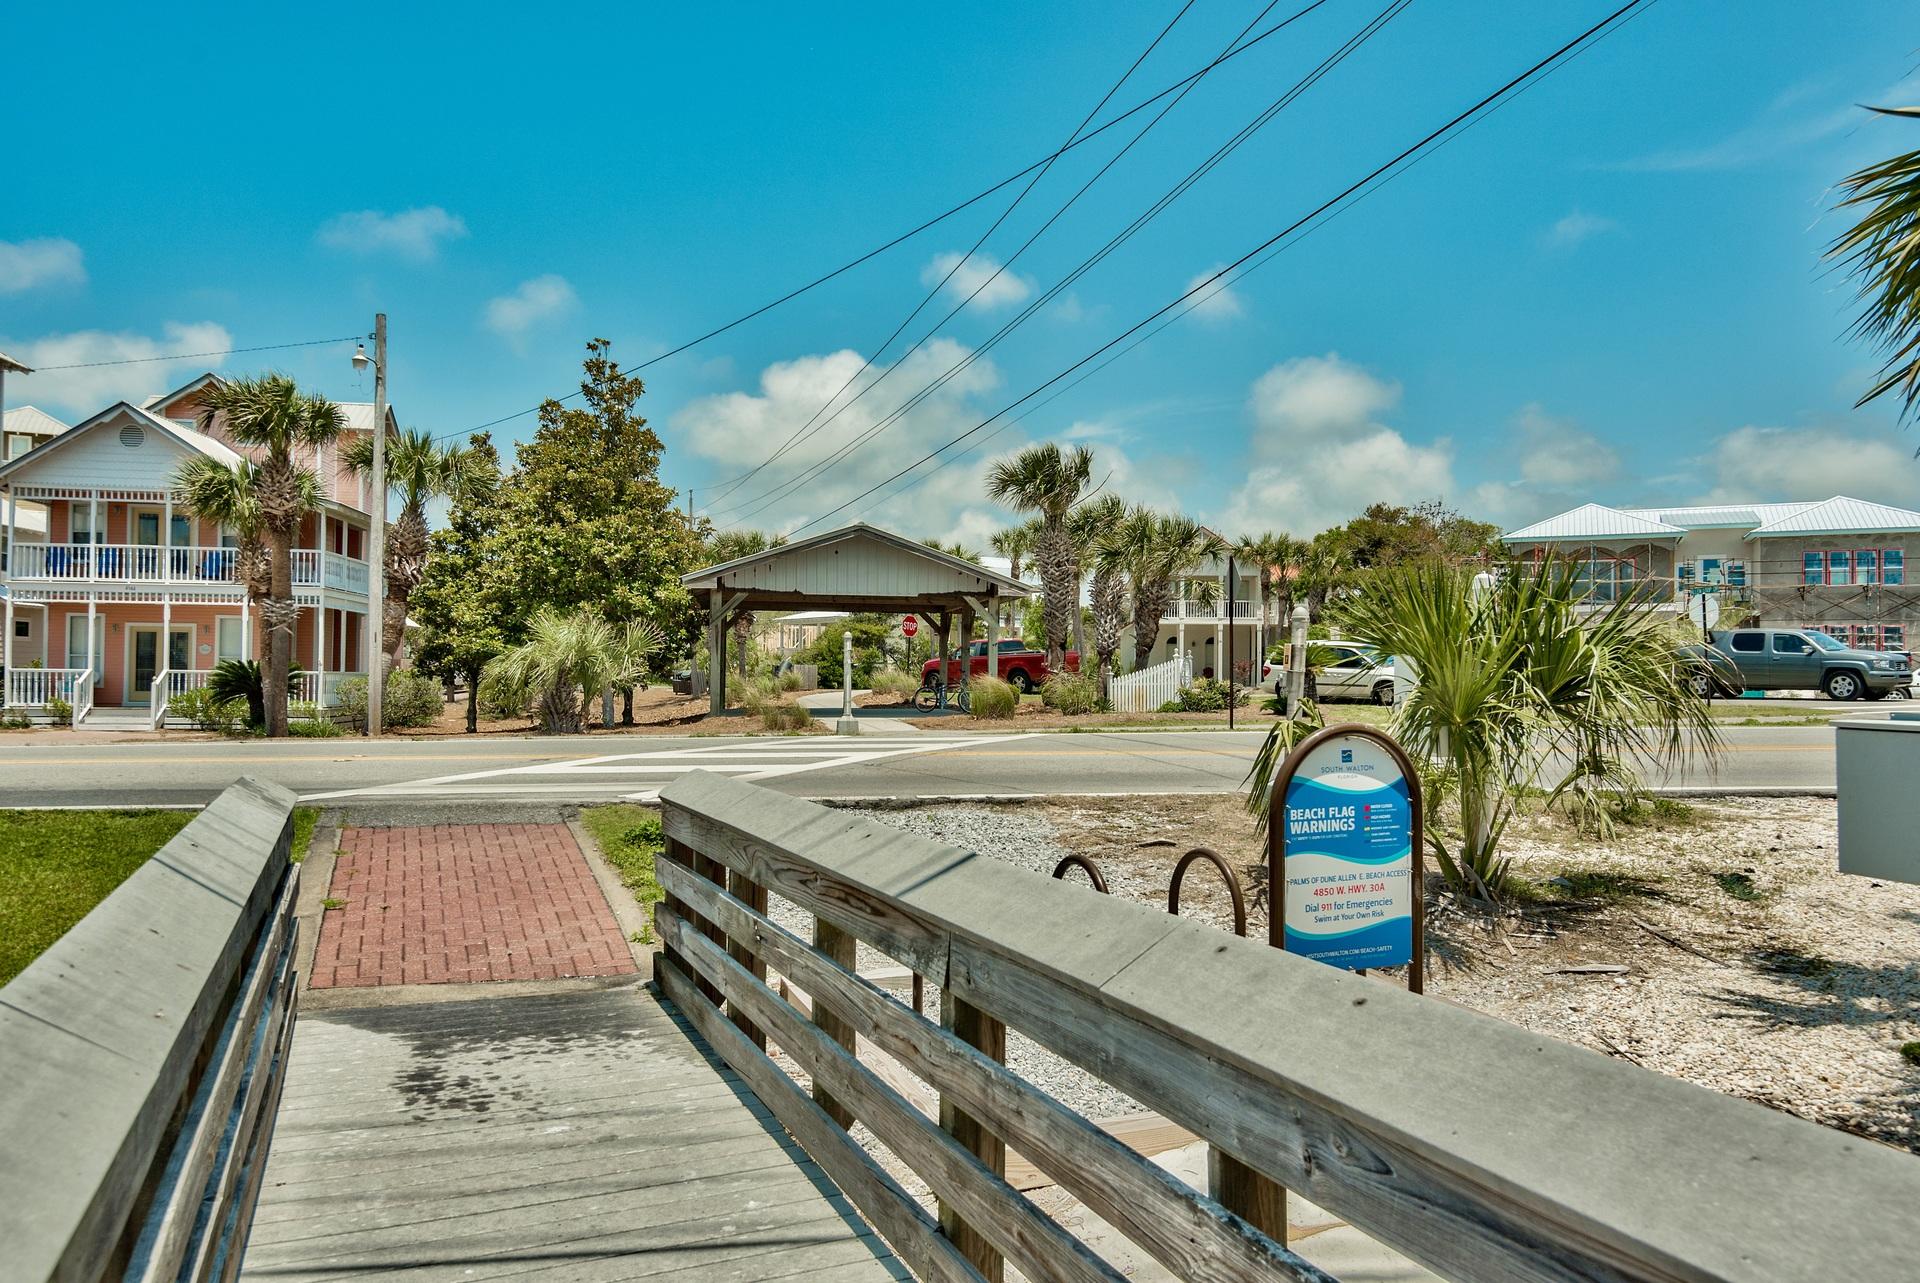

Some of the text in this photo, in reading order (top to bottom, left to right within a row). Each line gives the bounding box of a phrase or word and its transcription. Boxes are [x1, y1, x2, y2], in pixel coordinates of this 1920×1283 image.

[903, 621, 918, 631] STOP
[1320, 764, 1375, 774] SOUTH WALTON
[1290, 807, 1326, 821] BEACH
[1328, 805, 1356, 818] FLAG
[1290, 818, 1356, 835] WARNINGS
[1289, 877, 1310, 886] PALMS
[1311, 876, 1320, 884] OF
[1320, 875, 1337, 884] DUNE
[1337, 873, 1357, 882] ALLEN
[1365, 871, 1386, 880] BEACH
[1386, 869, 1408, 878] ACCESS
[1313, 882, 1385, 897] 4850 W. HWY. 30A
[1305, 897, 1393, 913] Dial 911 for Emergencies
[1314, 915, 1332, 923] Swim
[1341, 912, 1355, 921] Your
[1356, 911, 1371, 920] Own
[1371, 909, 1385, 918] Risk
